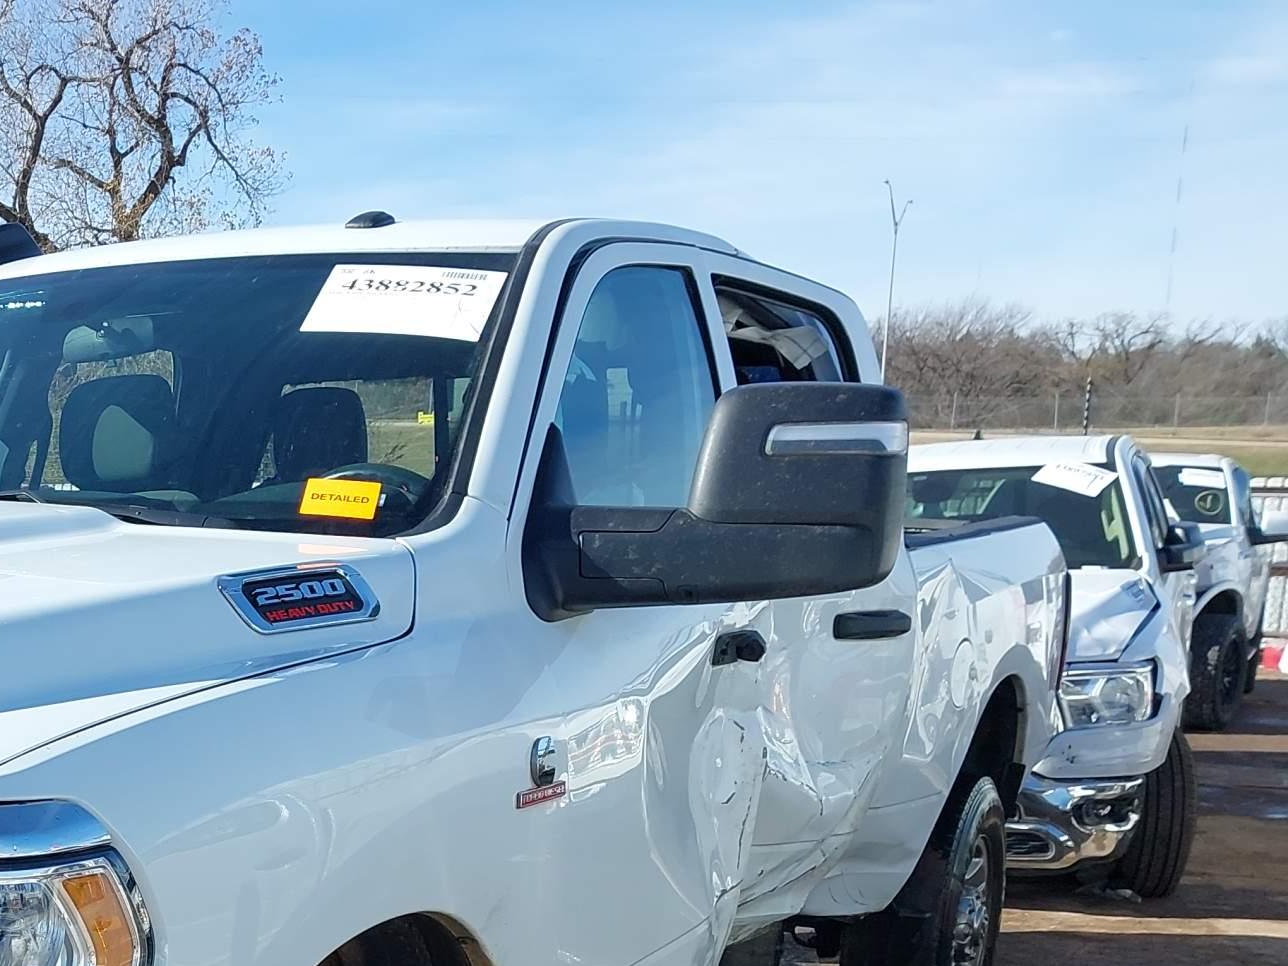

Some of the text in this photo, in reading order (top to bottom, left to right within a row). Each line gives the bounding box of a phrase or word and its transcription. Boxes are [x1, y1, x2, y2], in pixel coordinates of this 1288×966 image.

[341, 278, 478, 296] 43882852
[310, 492, 370, 504] DETAILED
[252, 578, 346, 606] 2500
[266, 600, 355, 621] HEAVY DUTY
